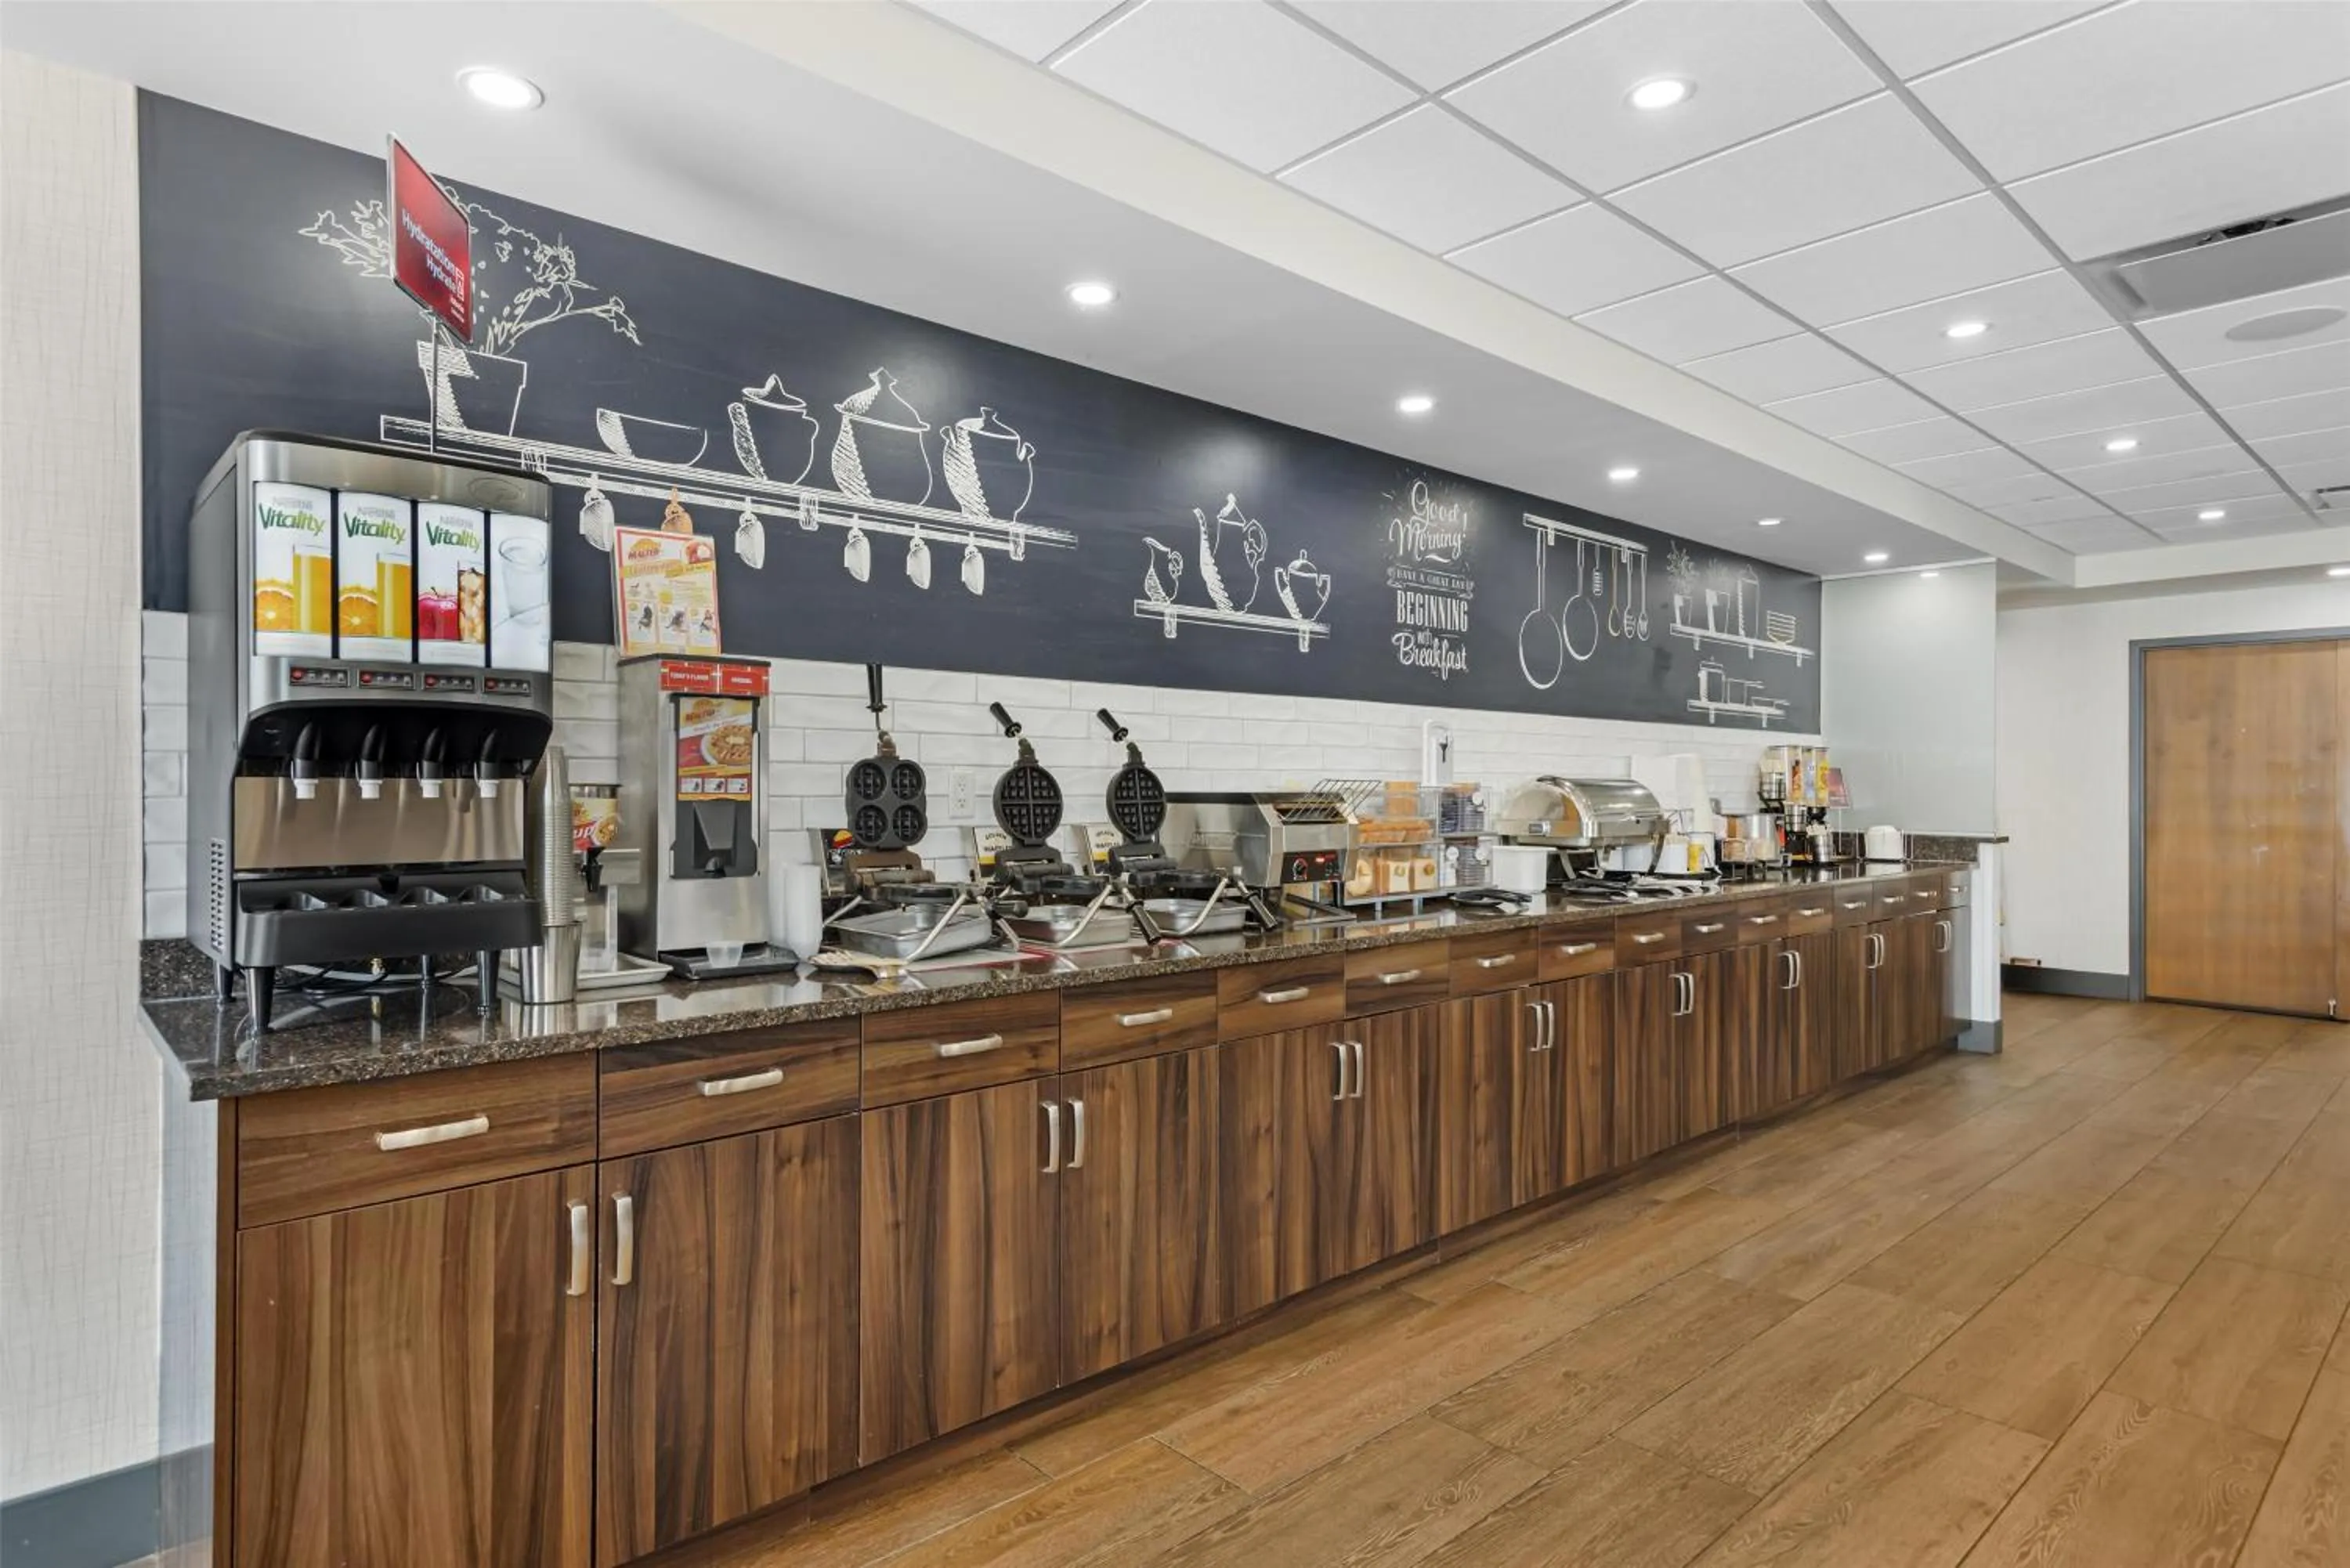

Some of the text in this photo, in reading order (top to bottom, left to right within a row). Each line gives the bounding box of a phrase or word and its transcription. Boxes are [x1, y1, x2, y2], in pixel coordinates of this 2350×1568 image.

[258, 503, 326, 537] Vitality
[1411, 480, 1459, 533] Good
[343, 511, 406, 545] Vitality
[425, 520, 480, 553] Vitality
[1397, 590, 1468, 632] BEGINNING
[1391, 632, 1467, 681] Breakfast
